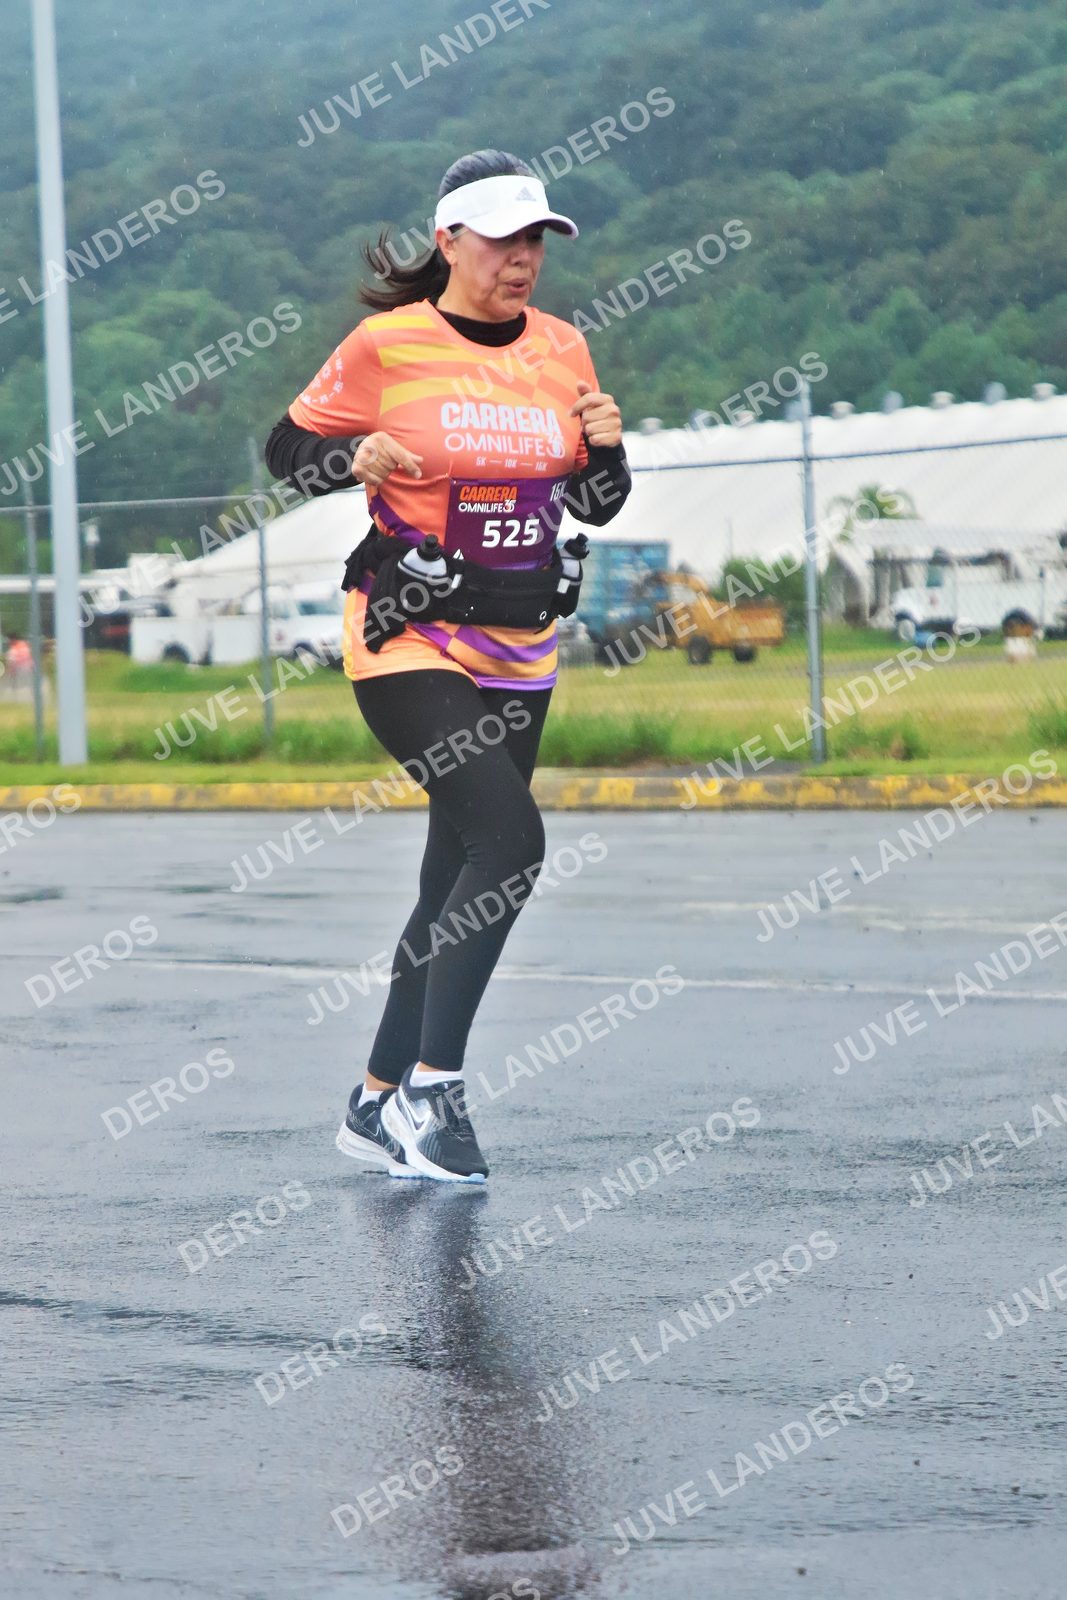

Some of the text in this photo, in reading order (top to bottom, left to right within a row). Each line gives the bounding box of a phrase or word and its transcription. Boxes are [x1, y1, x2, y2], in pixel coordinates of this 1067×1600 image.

[441, 402, 562, 436] CARRERA
[445, 433, 546, 457] OMNILIFE
[459, 486, 518, 502] CARRERA
[458, 502, 503, 513] OMNILIFE
[481, 519, 540, 548] 525
